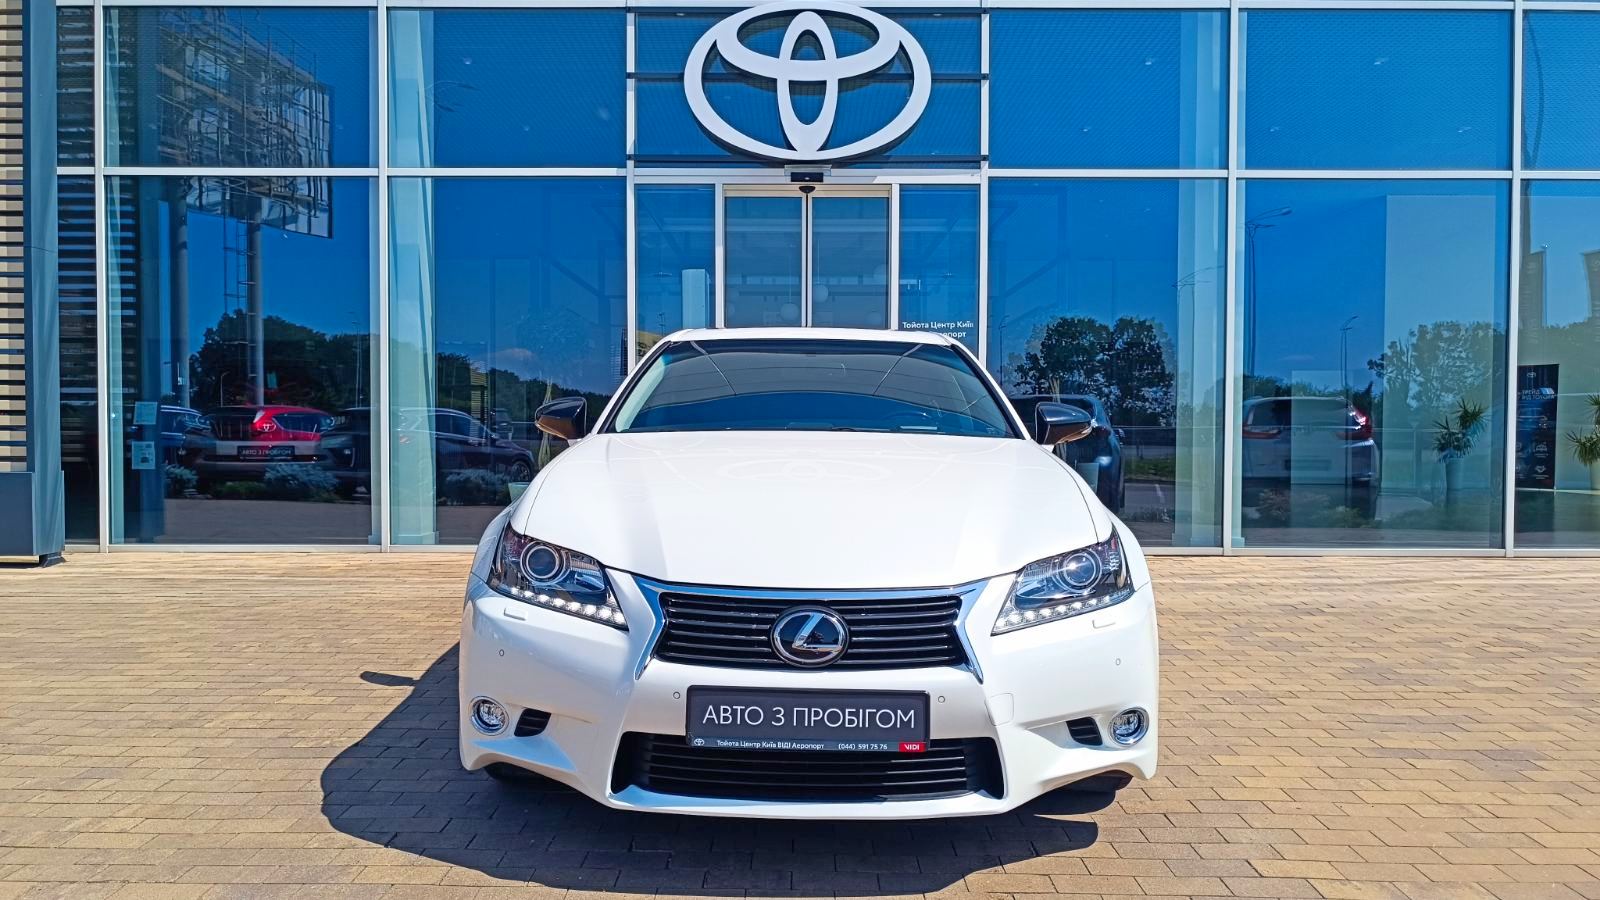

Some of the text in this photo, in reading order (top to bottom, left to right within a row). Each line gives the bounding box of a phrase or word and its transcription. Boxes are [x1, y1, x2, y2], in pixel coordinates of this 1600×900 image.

[902, 321, 929, 329] Тойота
[930, 321, 955, 330] Центр
[702, 705, 764, 726] АВТО
[793, 707, 915, 729] ПРОБІГОМ
[740, 740, 761, 749] Центр
[777, 741, 791, 749] ВІДІ
[791, 741, 824, 750] Аеропорт
